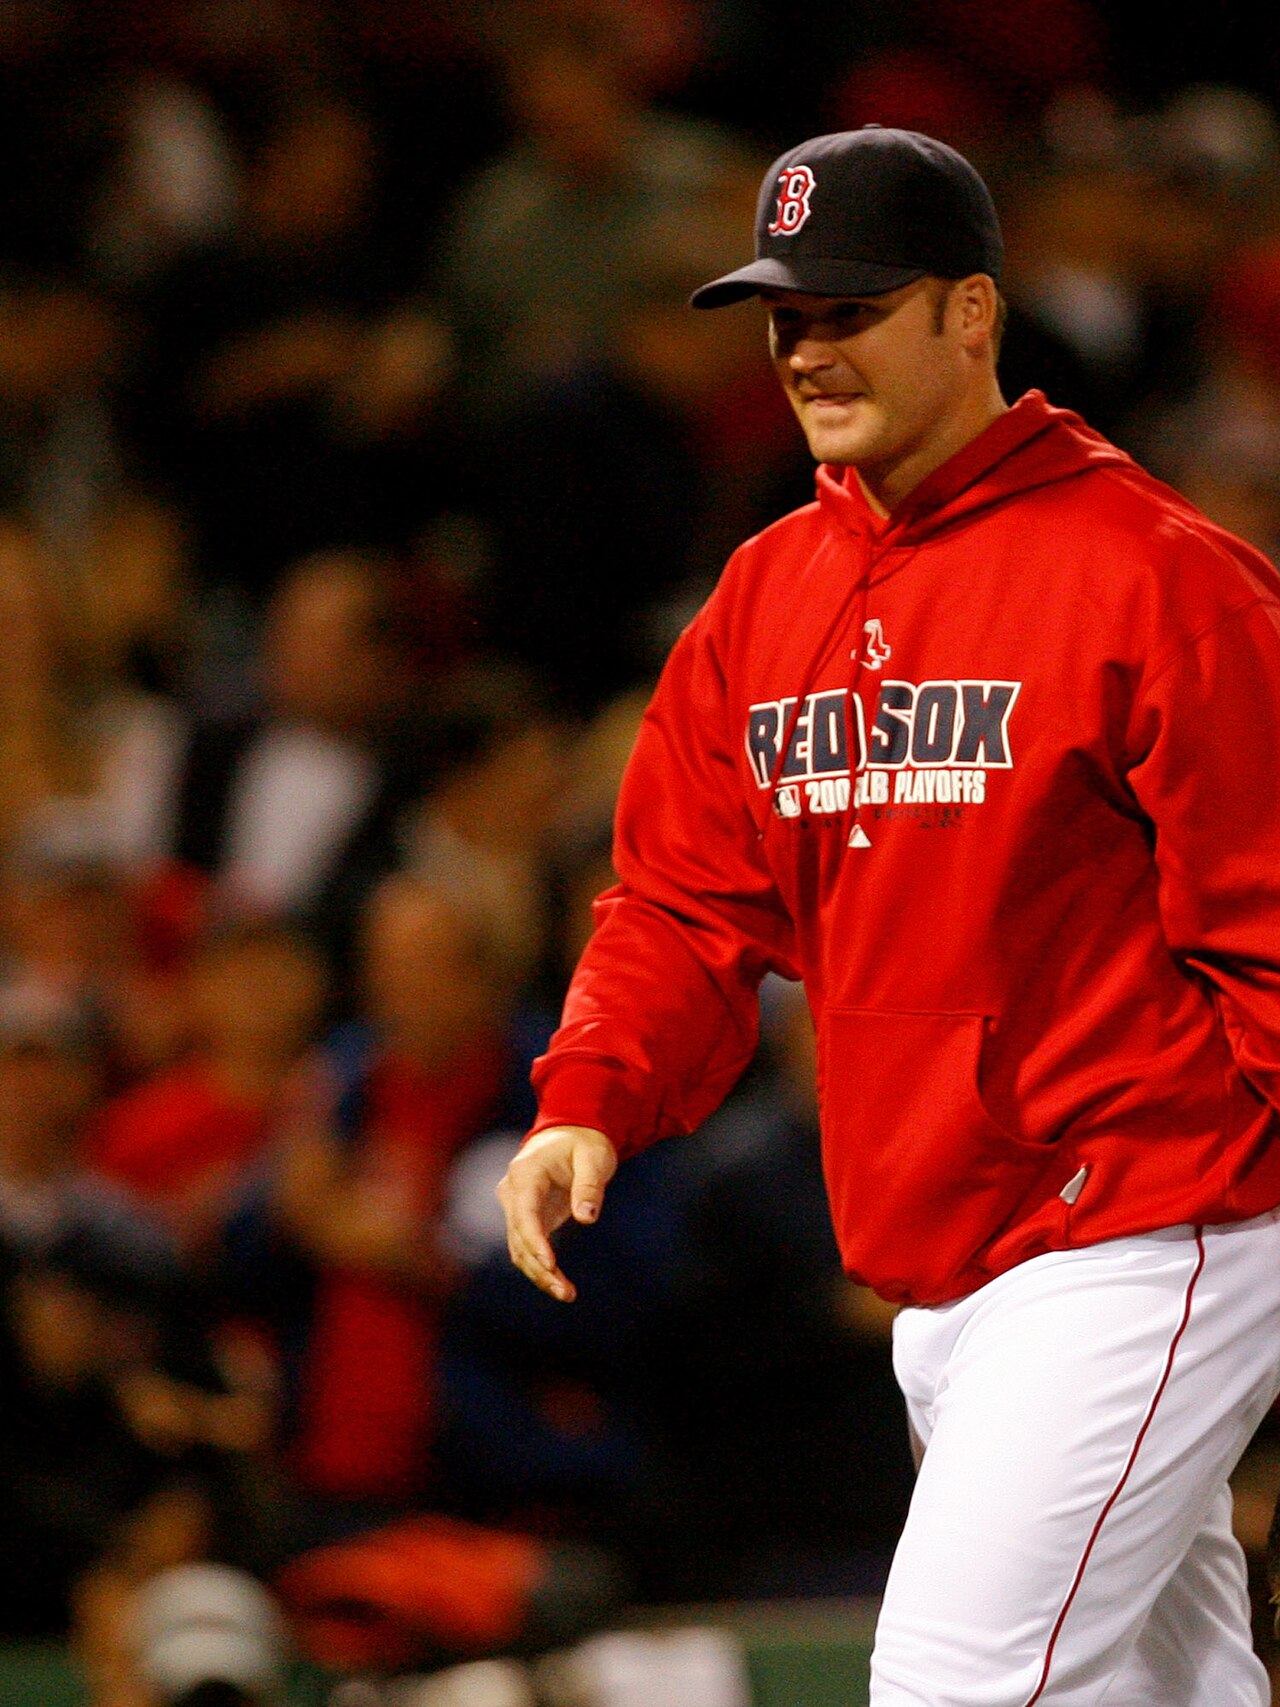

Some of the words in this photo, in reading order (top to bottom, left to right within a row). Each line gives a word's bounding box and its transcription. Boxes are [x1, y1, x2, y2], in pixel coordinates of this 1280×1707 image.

[768, 165, 817, 237] B
[744, 687, 867, 790] RED
[867, 679, 1023, 769] SOX
[894, 769, 987, 804] PLAYOFFS
